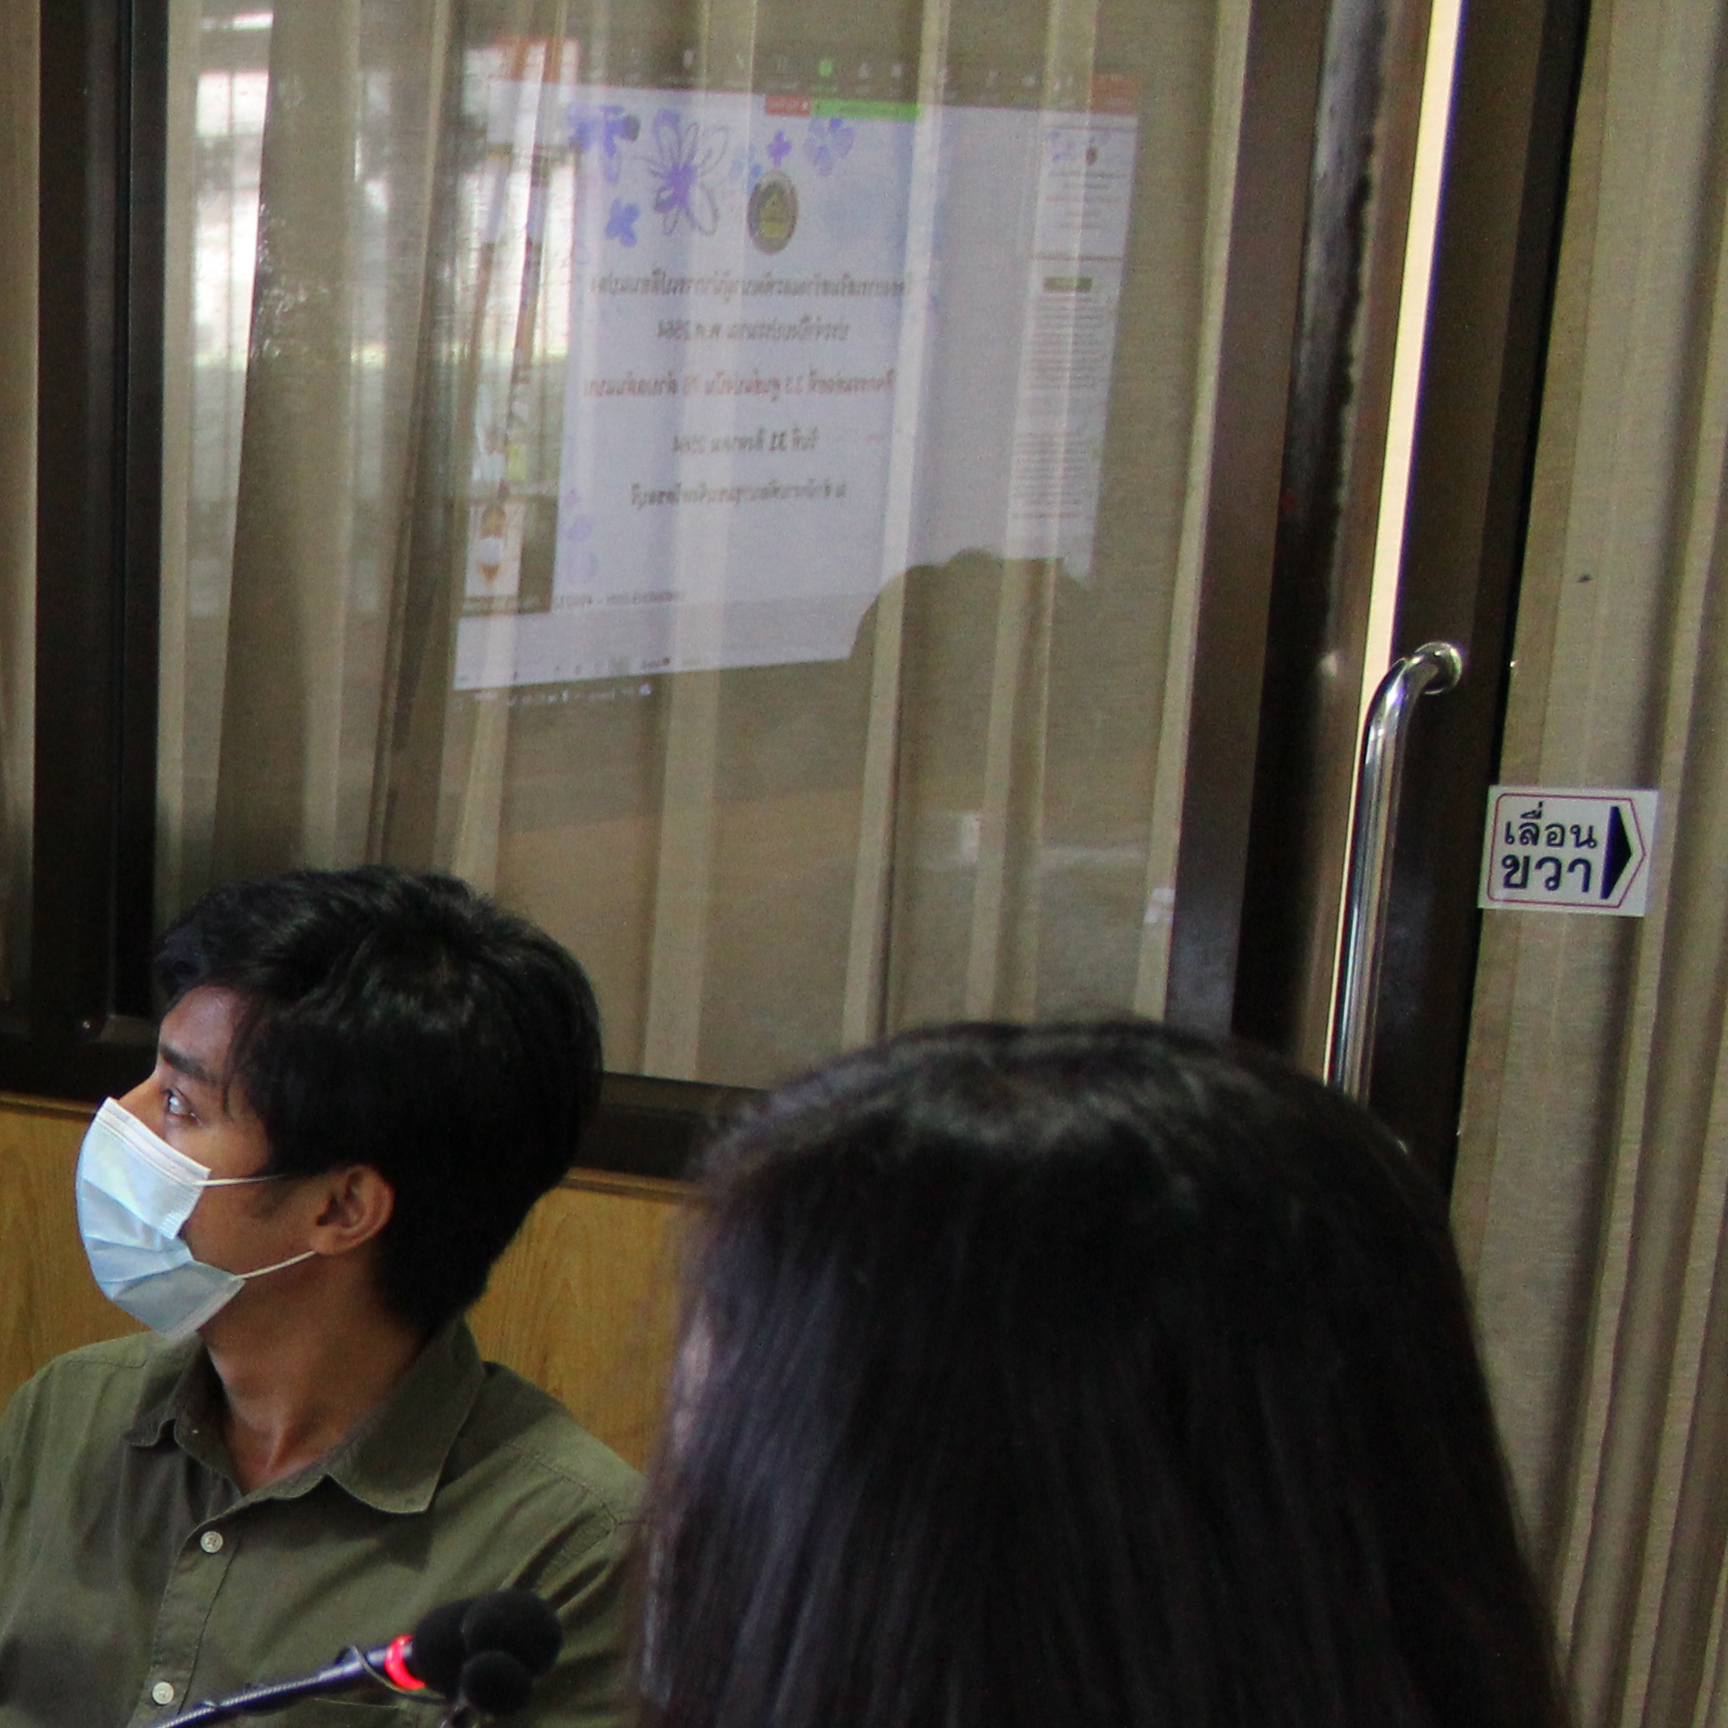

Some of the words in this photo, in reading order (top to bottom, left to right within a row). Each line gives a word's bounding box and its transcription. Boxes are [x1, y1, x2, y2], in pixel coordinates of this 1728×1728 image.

[1504, 801, 1598, 849] เลื่อน
[1501, 854, 1593, 893] ขวา
